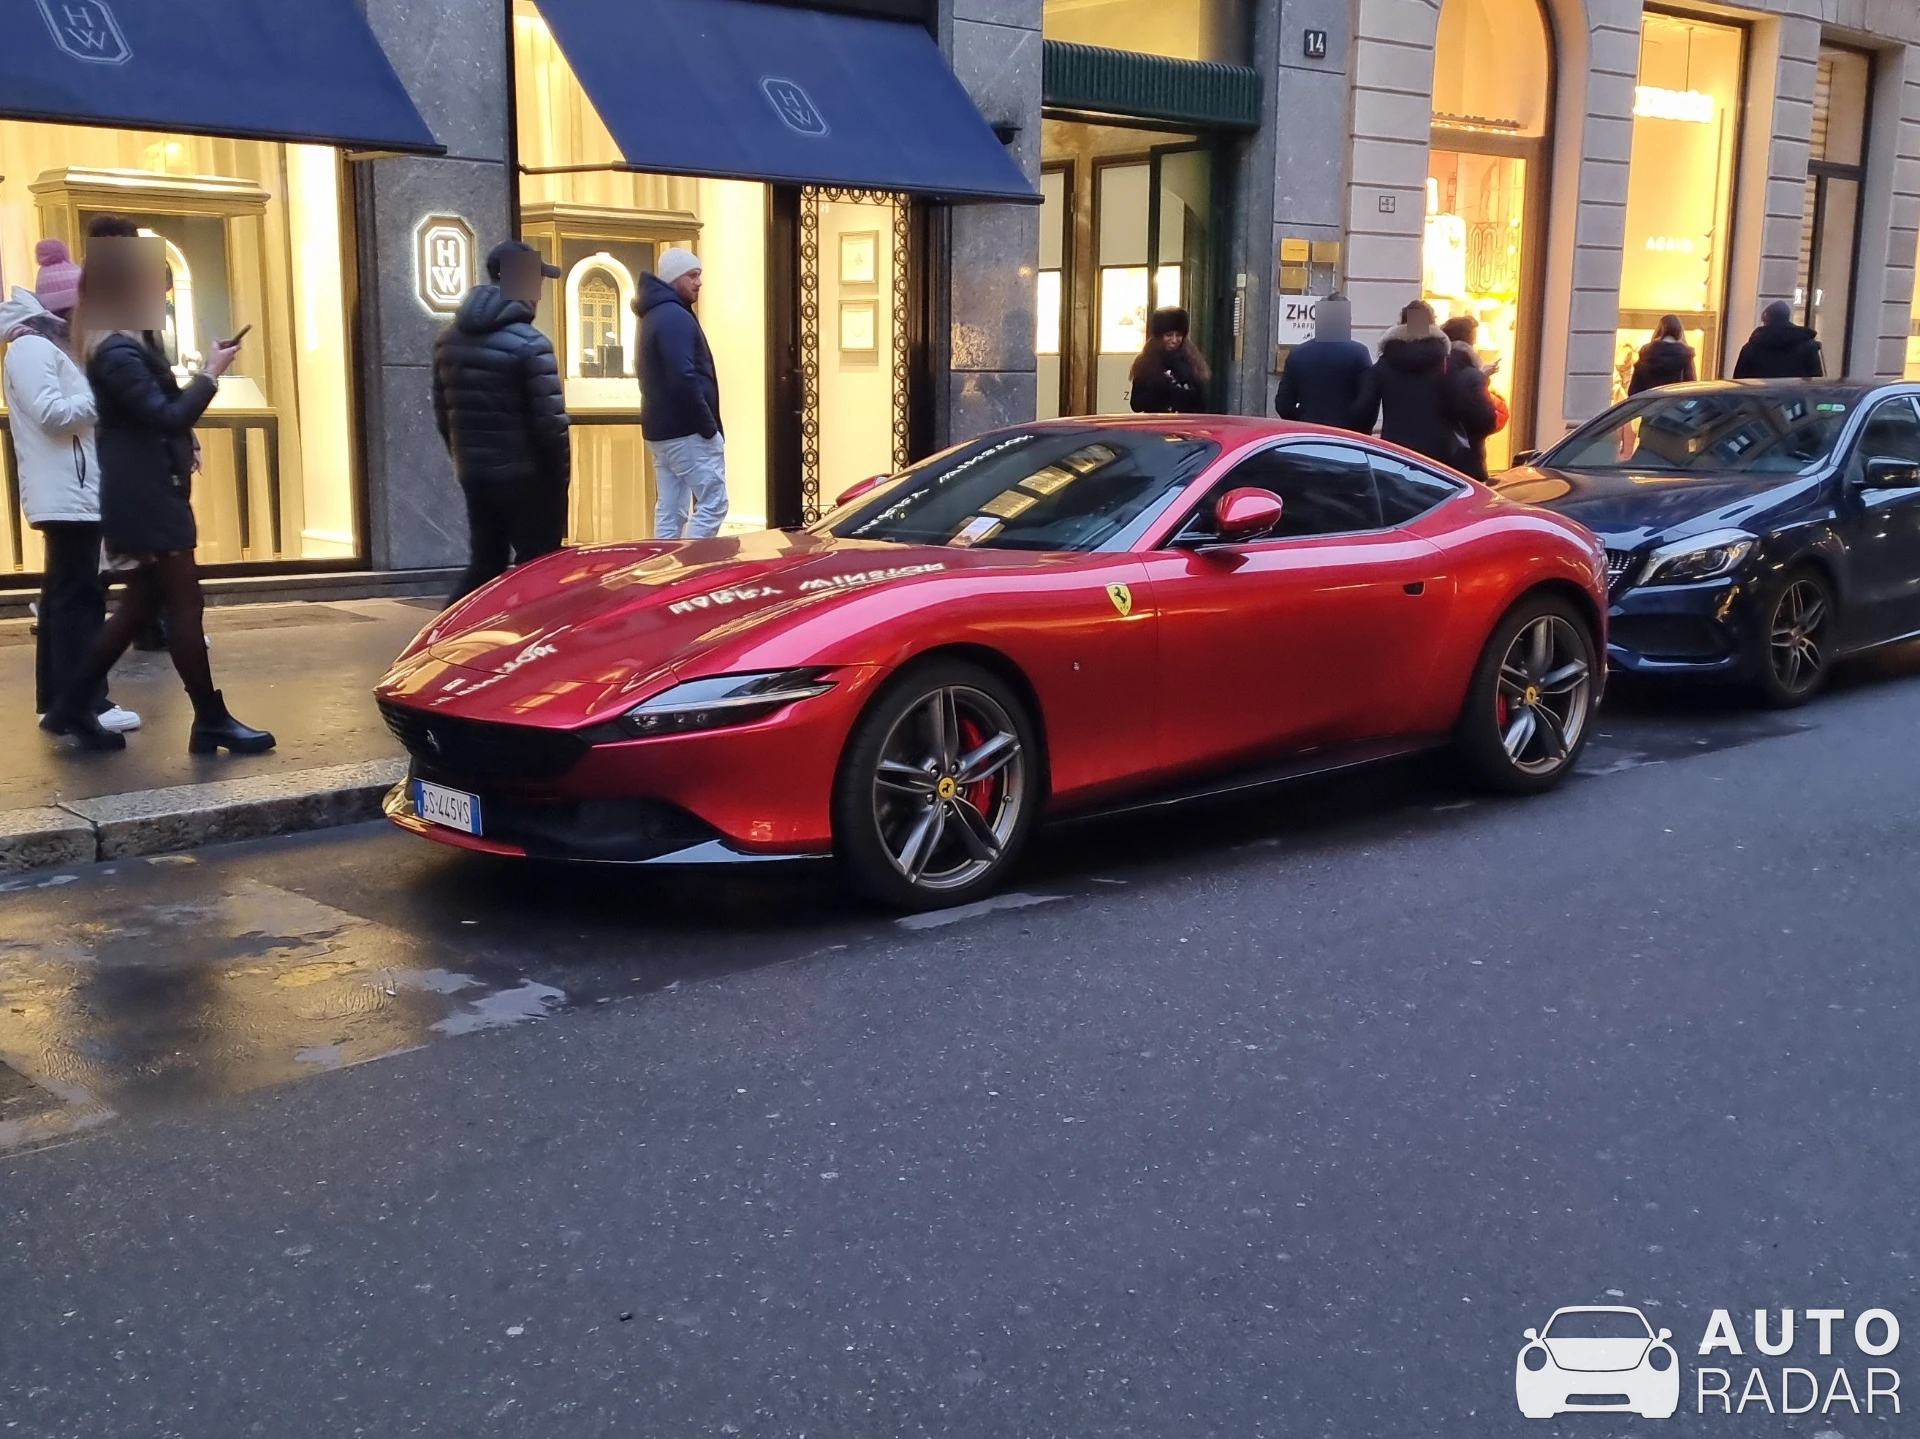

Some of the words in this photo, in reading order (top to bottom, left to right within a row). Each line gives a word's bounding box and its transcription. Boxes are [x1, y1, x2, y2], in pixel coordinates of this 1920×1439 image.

[1308, 32, 1324, 53] 14
[1286, 303, 1316, 321] ZHO
[1292, 322, 1315, 330] PARFU
